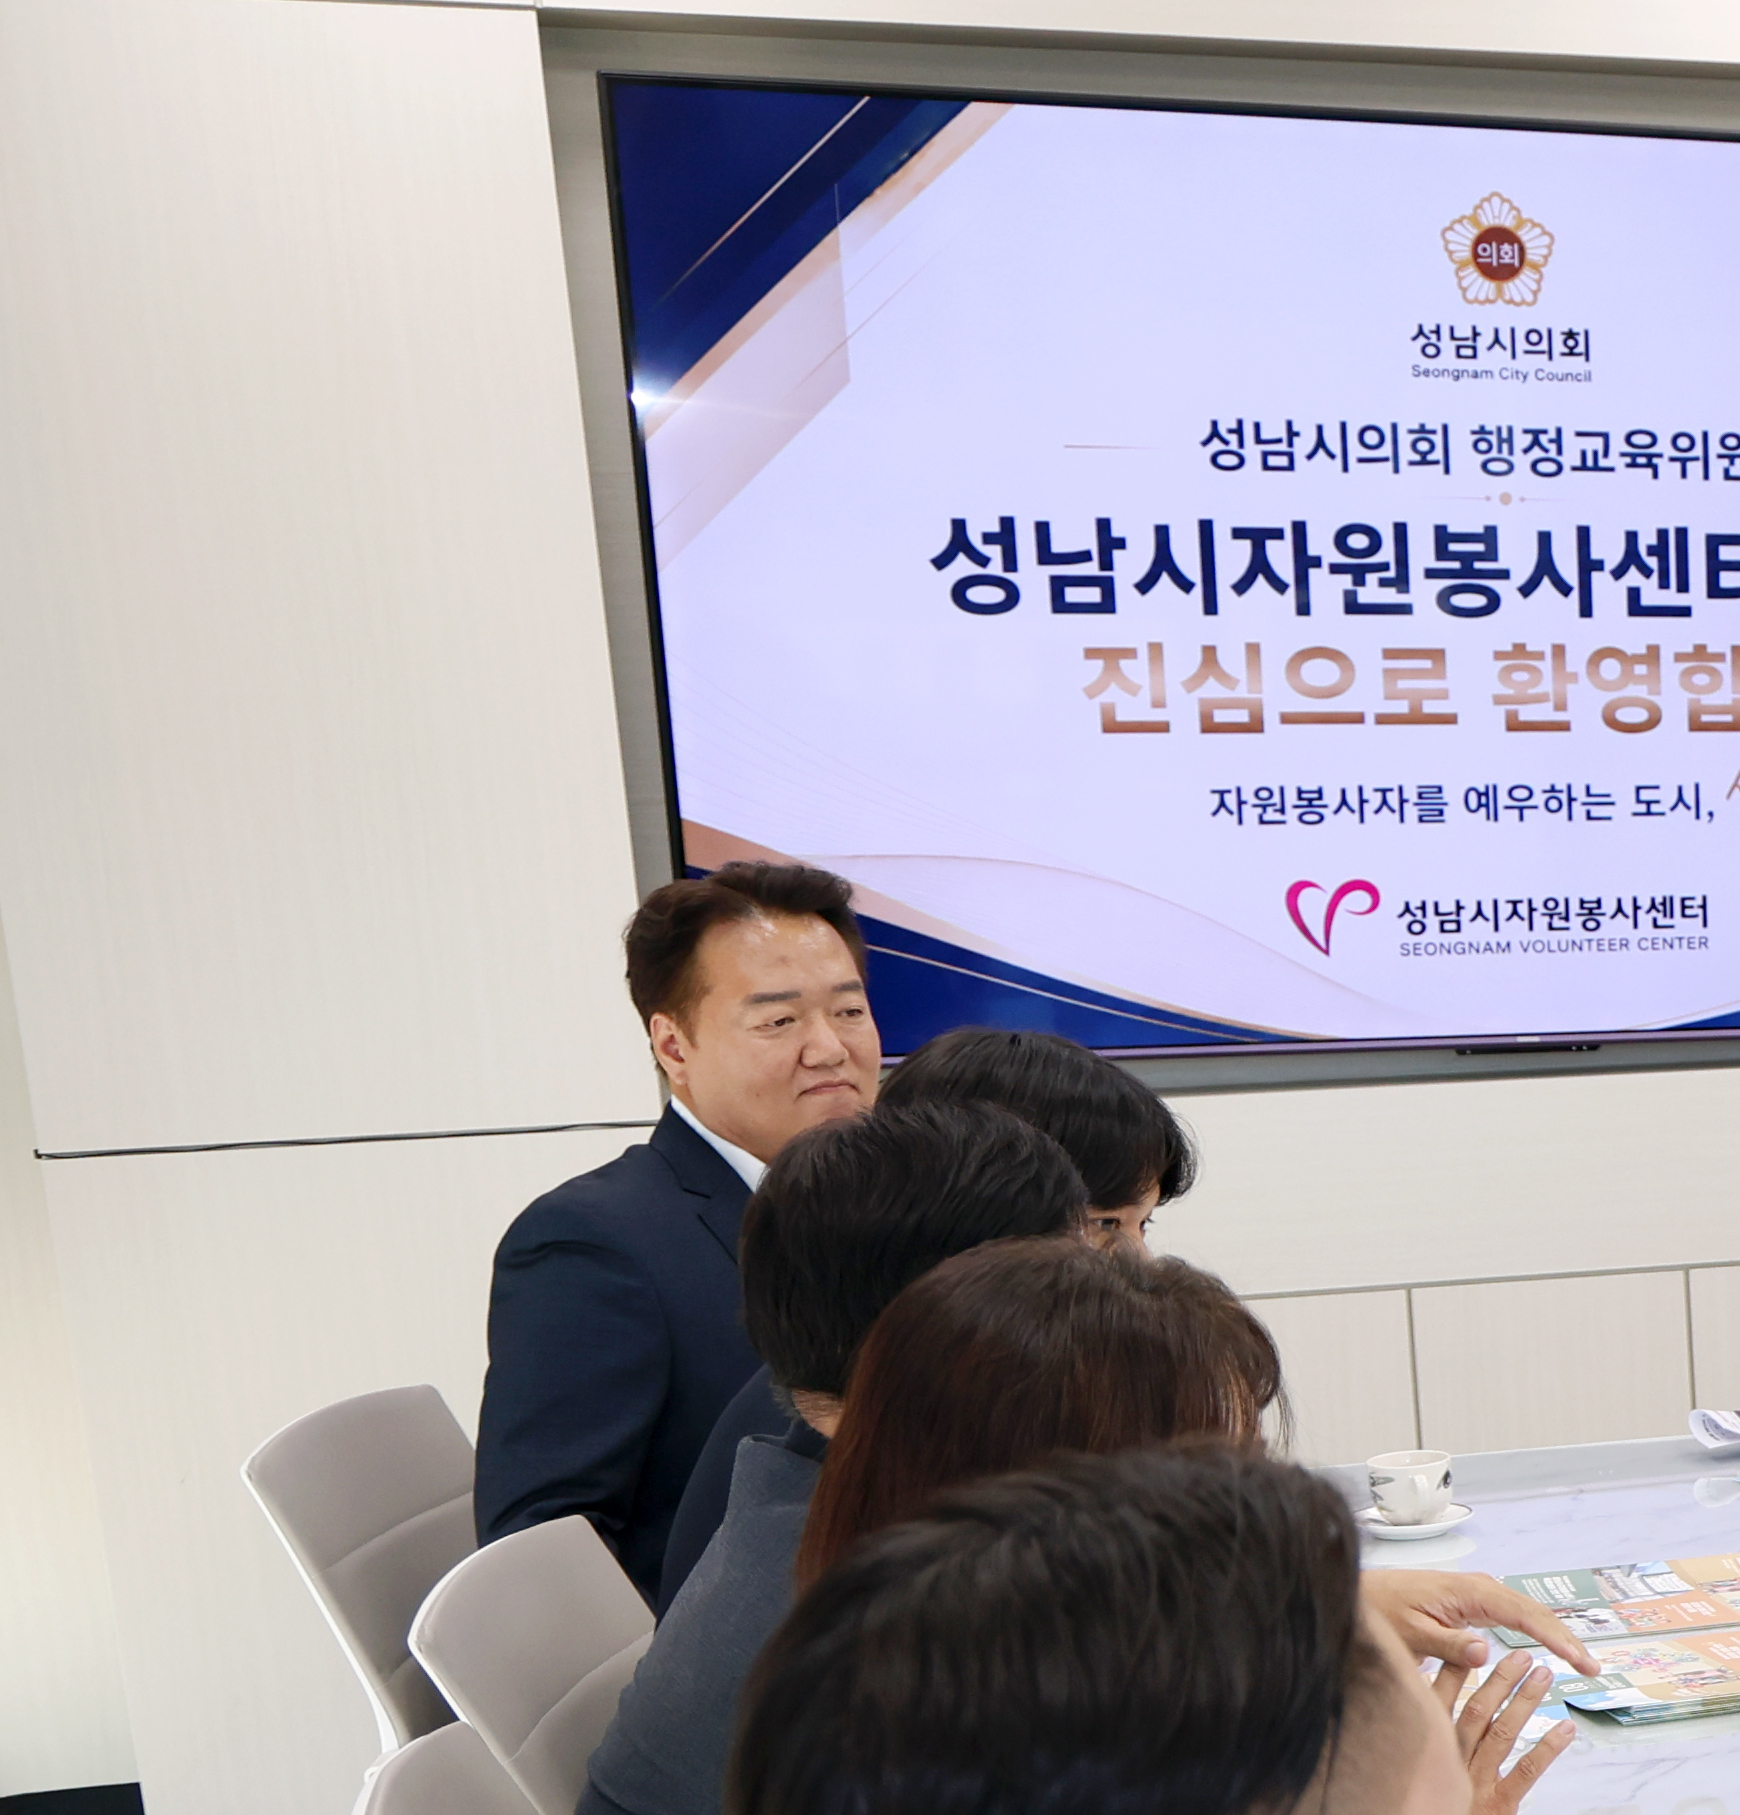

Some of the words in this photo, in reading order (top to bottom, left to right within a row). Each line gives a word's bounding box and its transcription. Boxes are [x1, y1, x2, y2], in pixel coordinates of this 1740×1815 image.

[1476, 240, 1520, 268] 의회
[1410, 323, 1591, 364] 성남시의회
[1412, 365, 1494, 383] Seongnam
[1499, 367, 1529, 383] City
[1534, 368, 1592, 383] Council
[1200, 417, 1451, 476] 성남시의회
[1082, 641, 1459, 735] 진심으로
[1209, 783, 1449, 826] 자원봉사자를
[1463, 782, 1617, 823] 예우하는
[1630, 781, 1715, 824] 도시,
[1396, 894, 1709, 936] 성남시자원봉사센터
[1400, 941, 1512, 957] SEONGNAM
[1519, 938, 1630, 954] VOLUNTEER
[1637, 936, 1709, 952] CENTER
